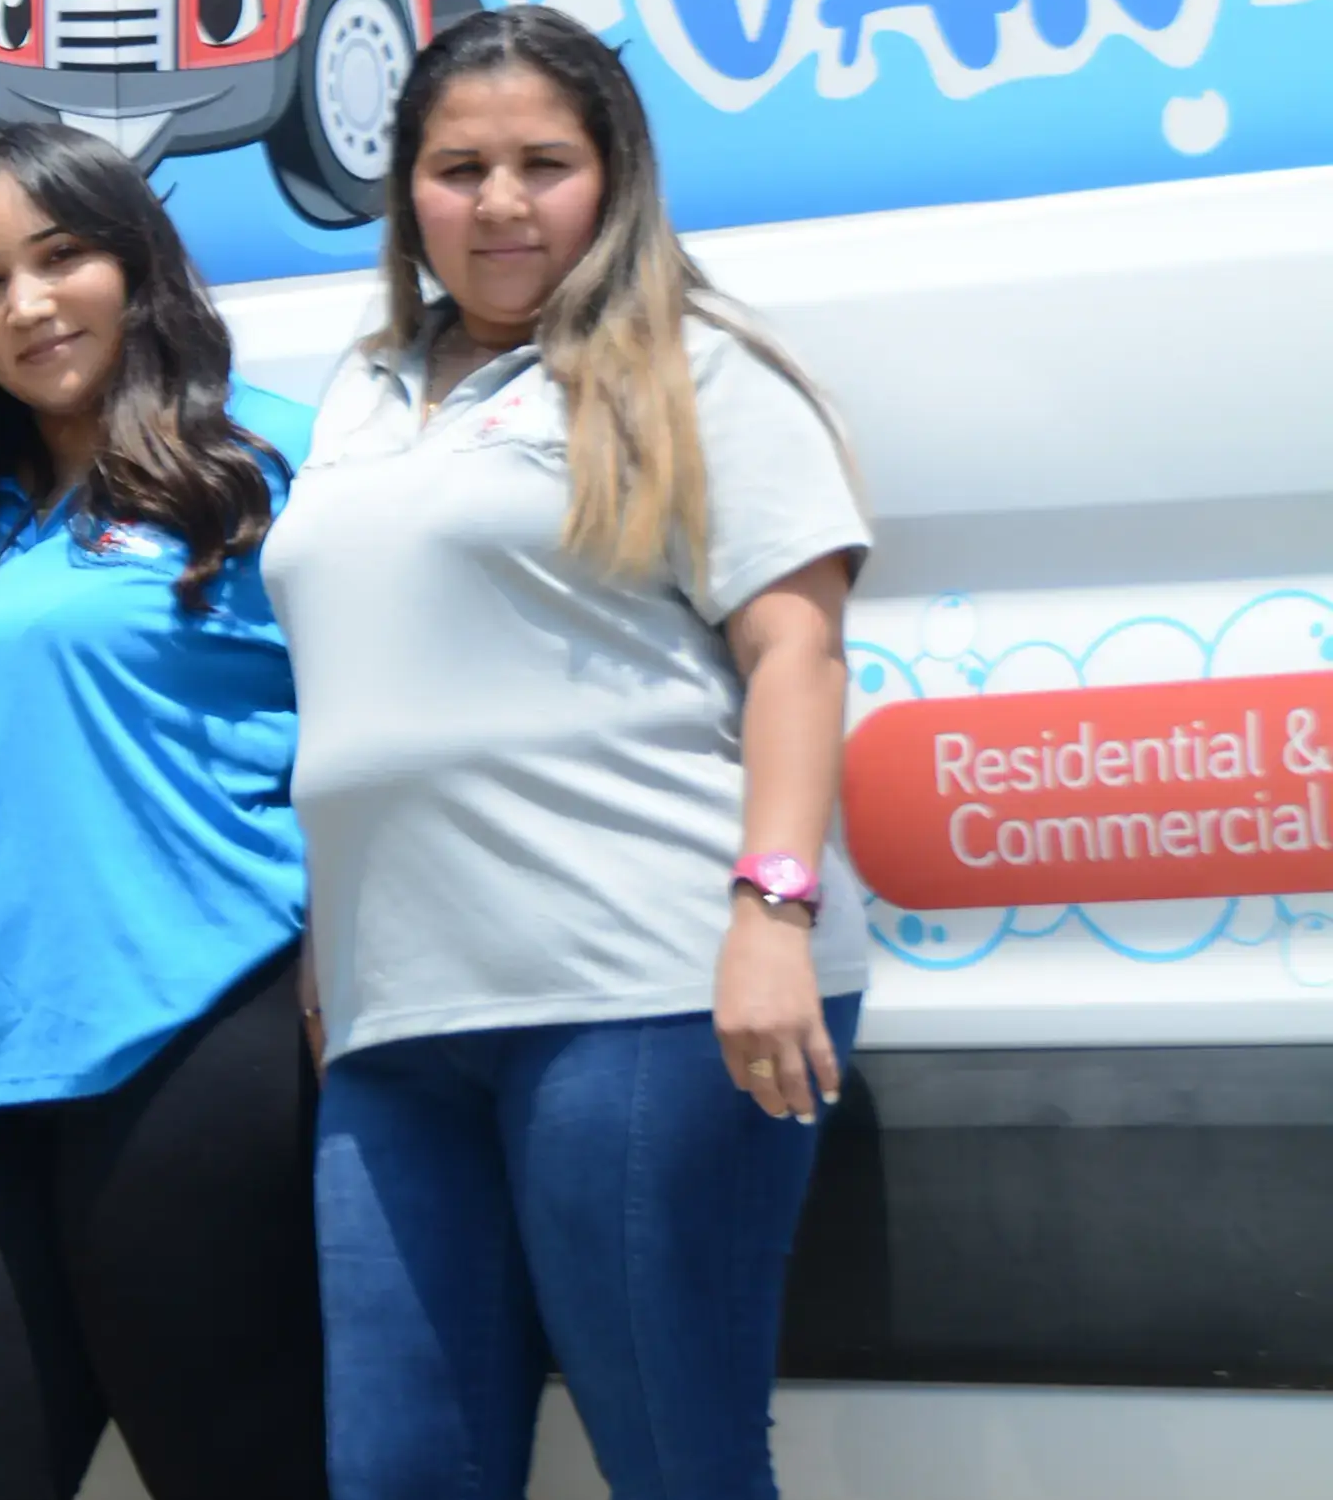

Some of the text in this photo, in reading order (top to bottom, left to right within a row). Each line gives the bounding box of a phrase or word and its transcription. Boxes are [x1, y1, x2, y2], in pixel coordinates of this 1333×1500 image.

[935, 706, 1333, 797] Residential &
[949, 780, 1333, 868] Commercial
